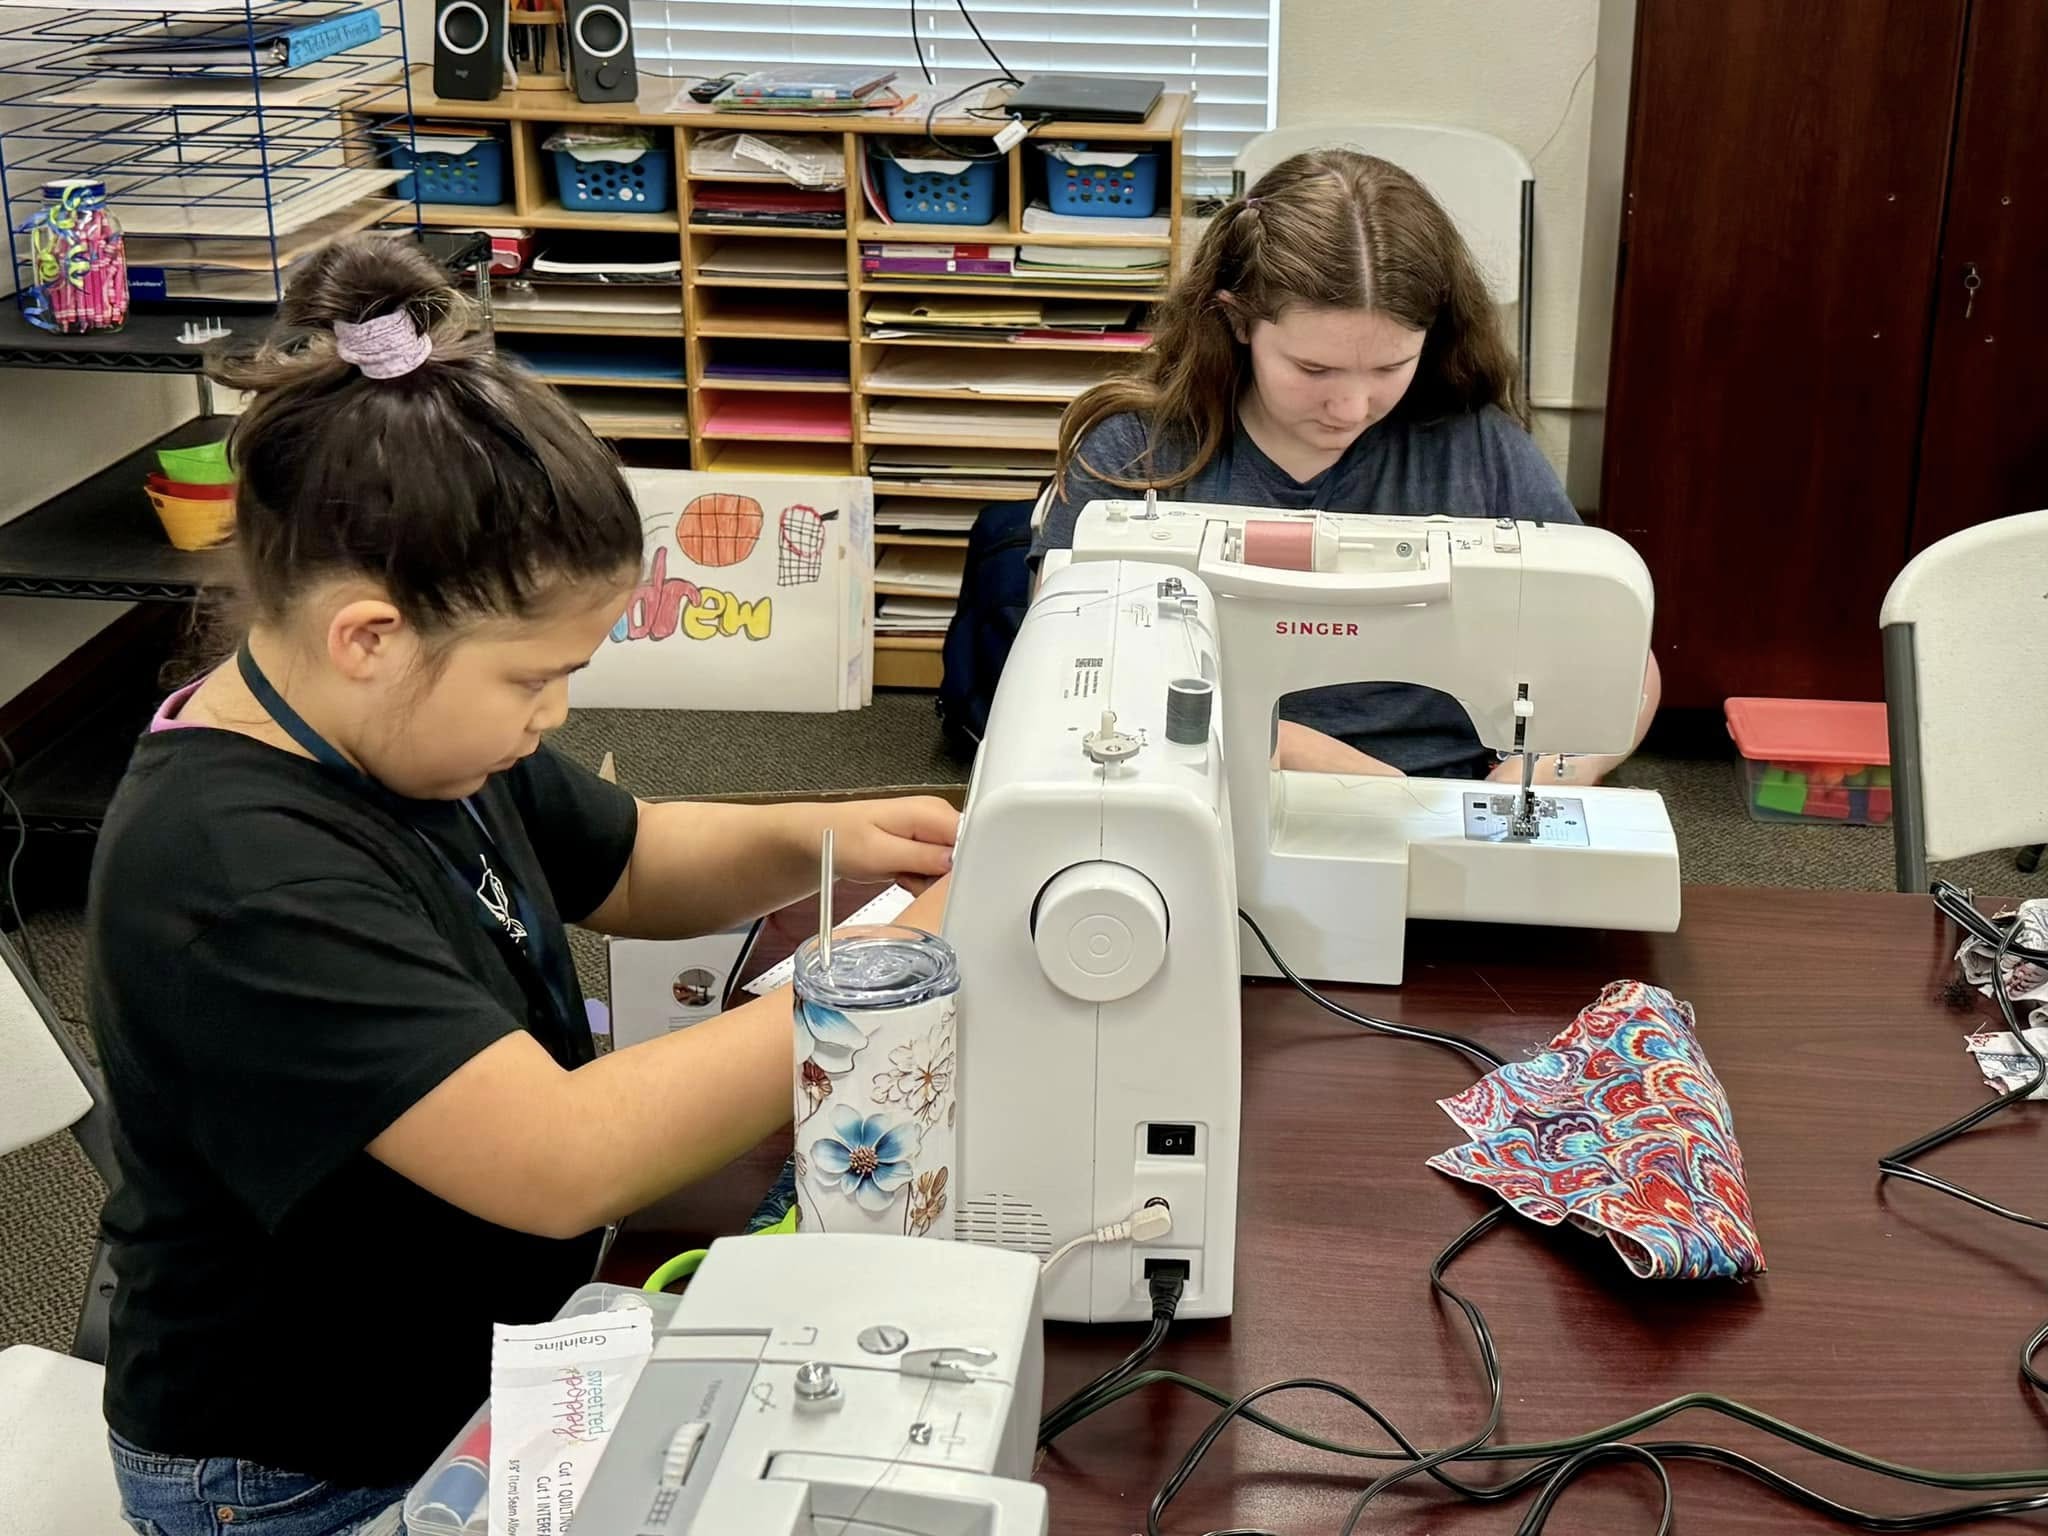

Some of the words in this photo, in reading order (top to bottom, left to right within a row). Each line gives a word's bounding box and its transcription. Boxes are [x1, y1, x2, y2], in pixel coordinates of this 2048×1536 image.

[609, 546, 772, 642] drew
[1275, 621, 1359, 636] SINGER
[534, 1335, 607, 1351] Grainline
[587, 1370, 606, 1409] sweet
[552, 1376, 587, 1441] poppy
[588, 1410, 612, 1435] red
[558, 1461, 572, 1477] Cut
[536, 1476, 551, 1493] Cut
[507, 1496, 520, 1517] Seam
